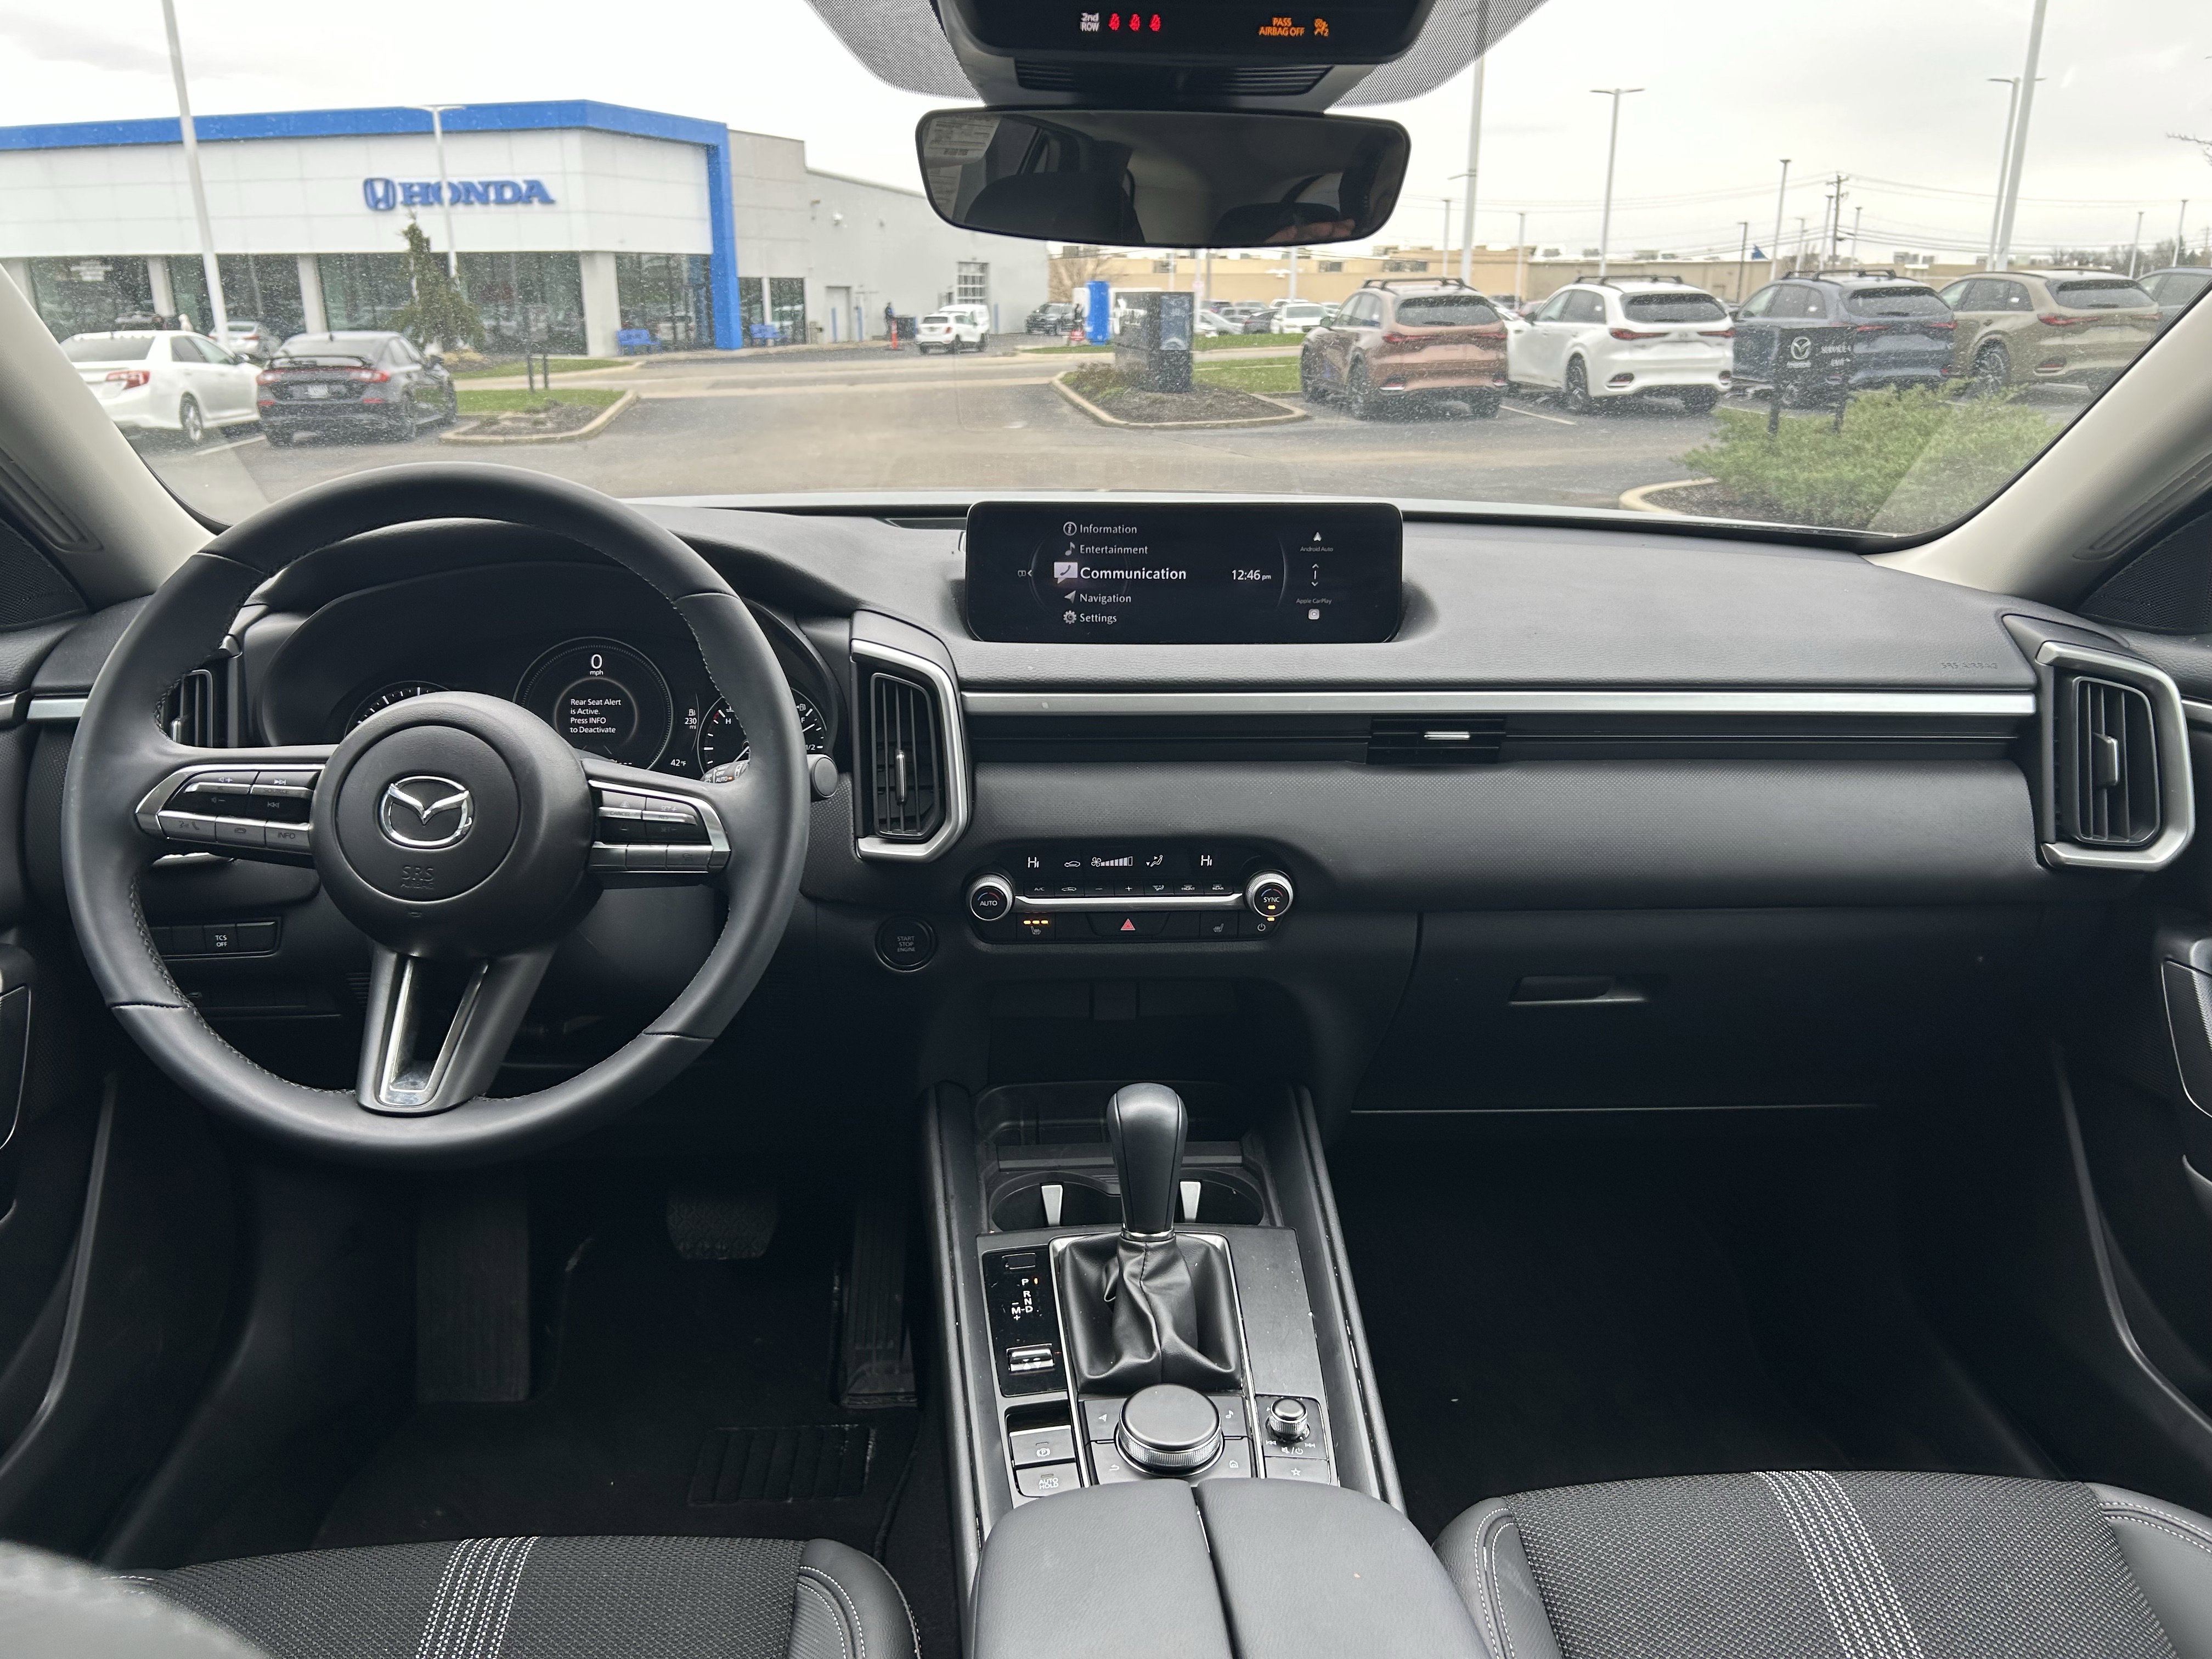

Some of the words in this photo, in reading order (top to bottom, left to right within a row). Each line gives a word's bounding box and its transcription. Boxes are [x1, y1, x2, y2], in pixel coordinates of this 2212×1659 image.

[1081, 13, 1099, 21] 2nd
[1273, 18, 1292, 26] PASS
[1080, 21, 1099, 31] ROW
[1259, 27, 1289, 36] AIRBAG
[1290, 27, 1305, 36] OFF
[399, 180, 555, 206] HONDA
[1080, 524, 1137, 534] Information
[1080, 545, 1148, 554] Entertainment
[1080, 567, 1187, 580] Communication
[1232, 569, 1261, 580] 12:46
[1080, 594, 1132, 605] Navigation
[1080, 613, 1117, 624] Settings
[591, 654, 602, 669] 0
[402, 866, 434, 882] SRS
[1024, 1297, 1032, 1306] N
